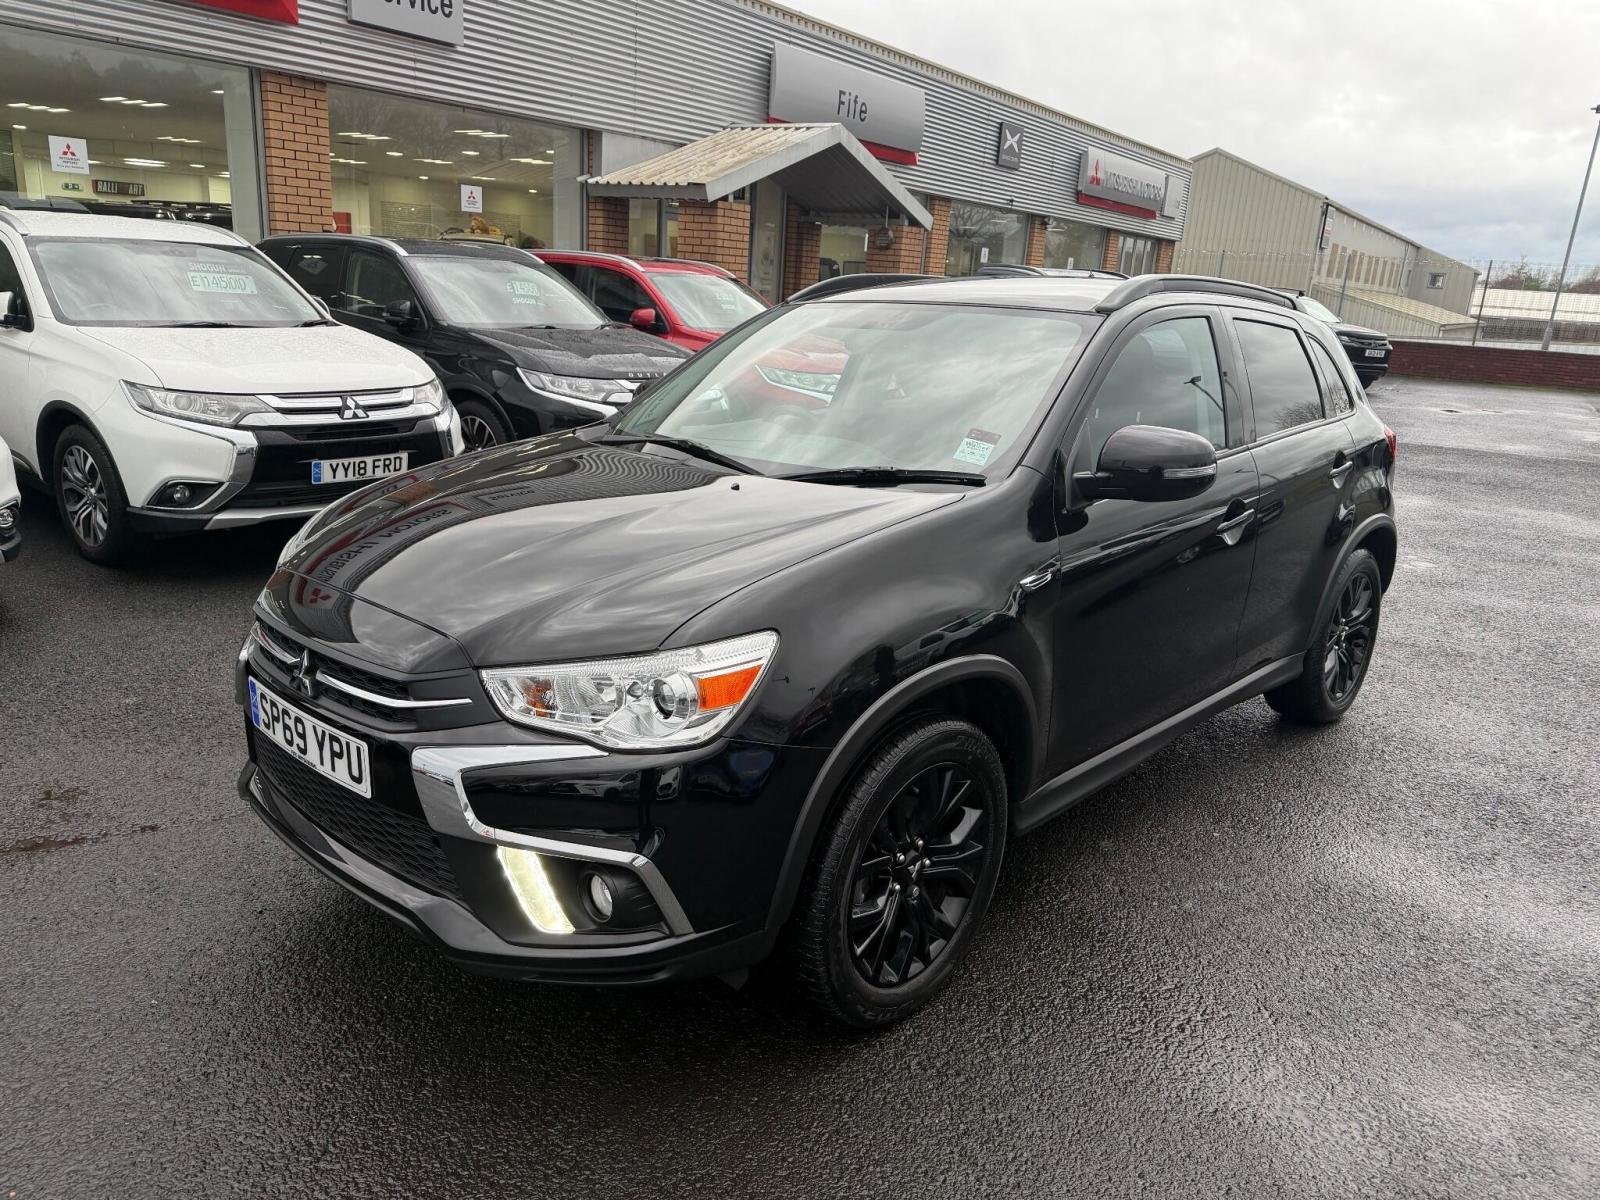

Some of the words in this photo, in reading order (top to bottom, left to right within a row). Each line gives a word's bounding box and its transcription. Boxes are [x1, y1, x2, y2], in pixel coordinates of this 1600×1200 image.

[837, 89, 868, 122] Fife
[97, 181, 118, 193] RALLI
[128, 183, 143, 196] ART
[329, 460, 367, 479] YY18
[372, 456, 403, 475] FRD
[260, 692, 308, 756] SP69
[312, 725, 364, 785] YPU
